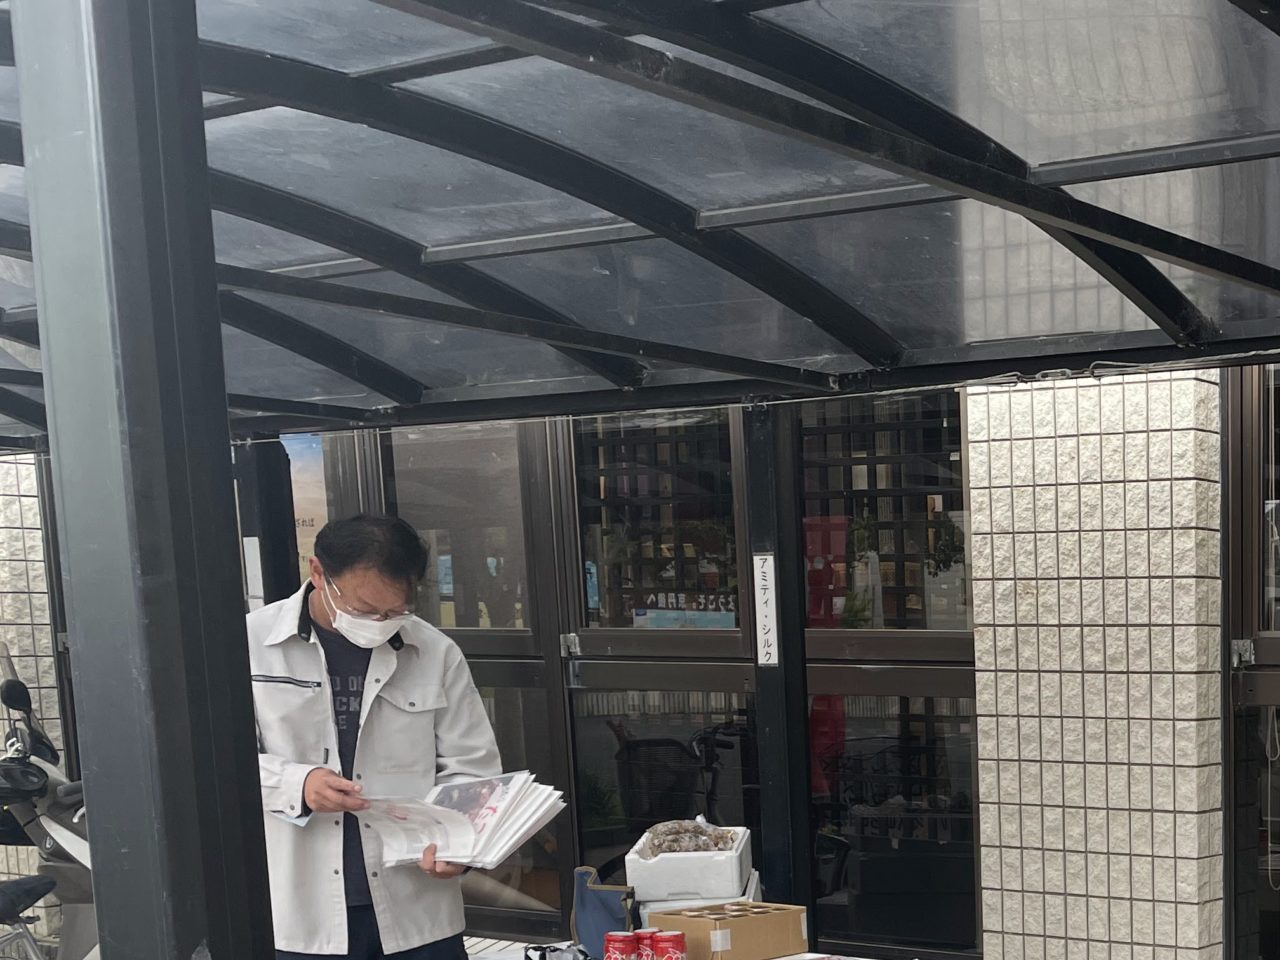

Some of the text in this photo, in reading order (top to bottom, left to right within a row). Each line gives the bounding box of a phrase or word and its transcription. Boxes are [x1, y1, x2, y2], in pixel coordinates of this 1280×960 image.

[758, 557, 772, 662] アミティ・シルク
